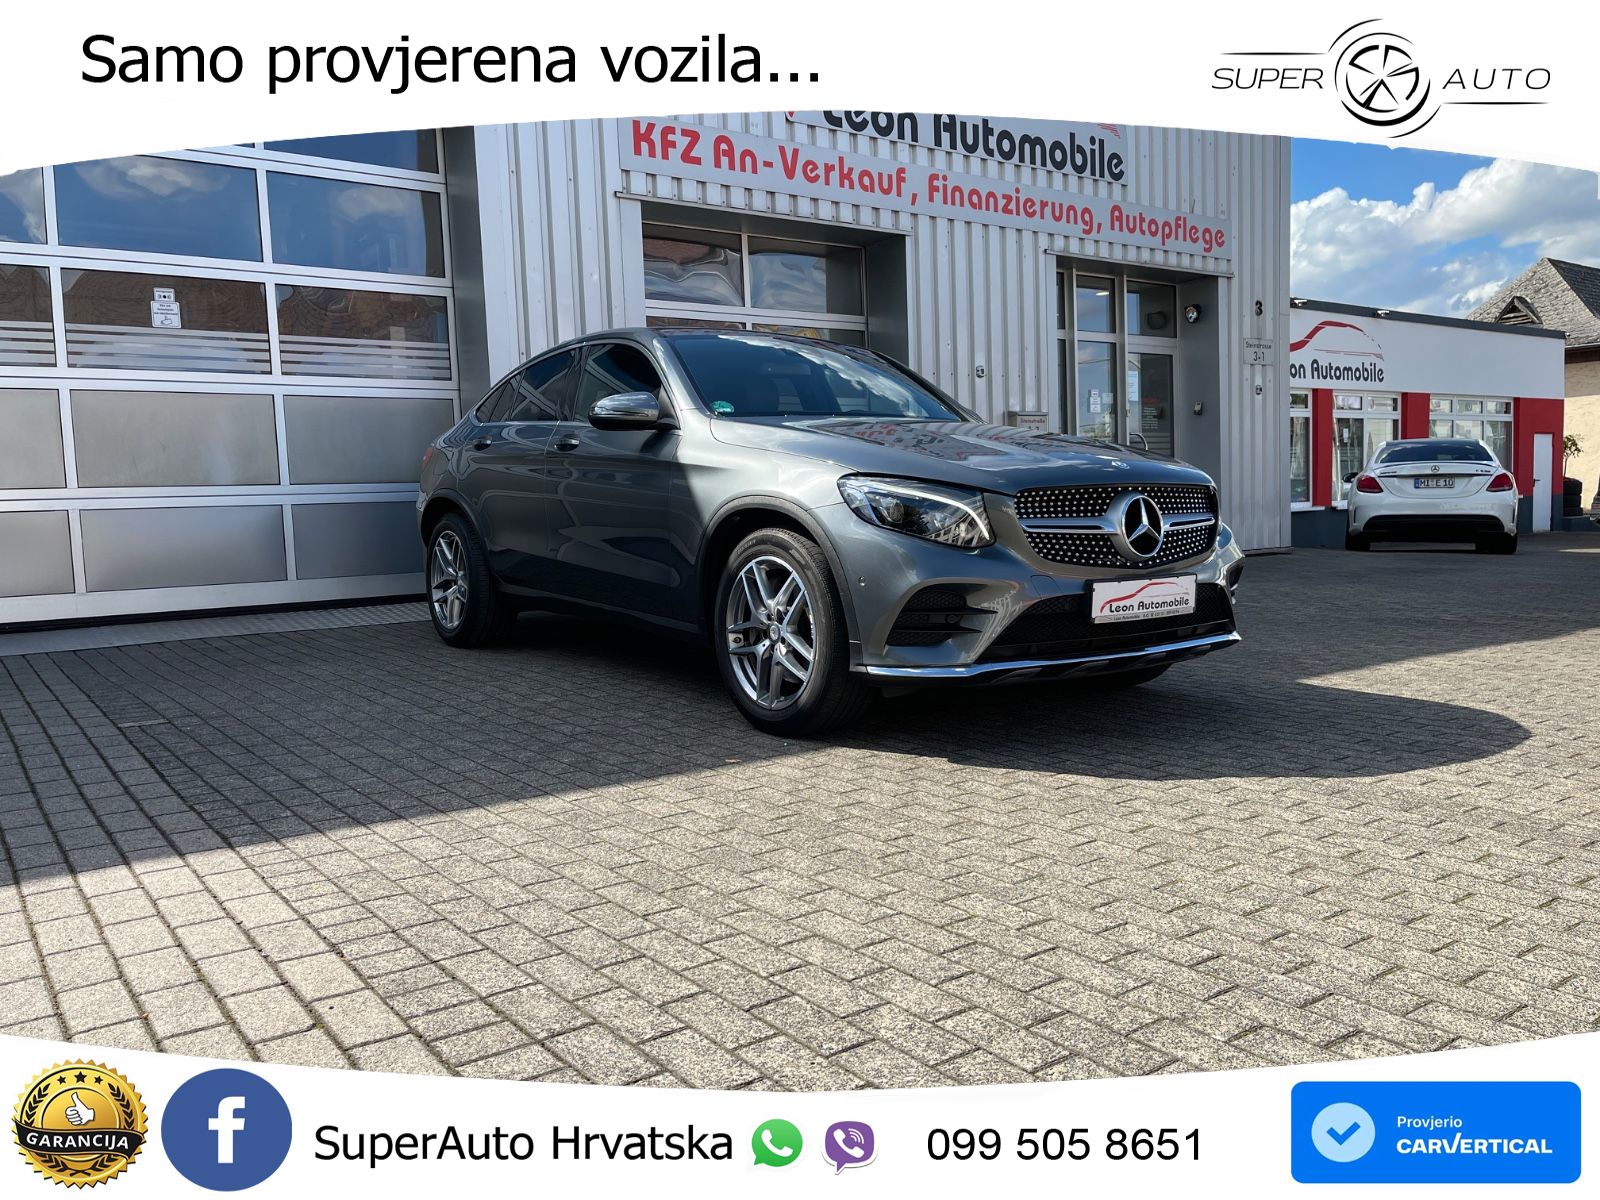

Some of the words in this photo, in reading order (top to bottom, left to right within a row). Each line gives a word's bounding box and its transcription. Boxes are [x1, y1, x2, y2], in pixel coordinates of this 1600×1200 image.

[933, 113, 1125, 182] Automobile
[927, 172, 1103, 235] Finanzierung,
[1109, 203, 1226, 254] Autopflege
[1254, 300, 1263, 317] 3
[1311, 358, 1385, 383] Automobile
[1109, 603, 1135, 614] Leon
[1137, 596, 1190, 612] Automobile
